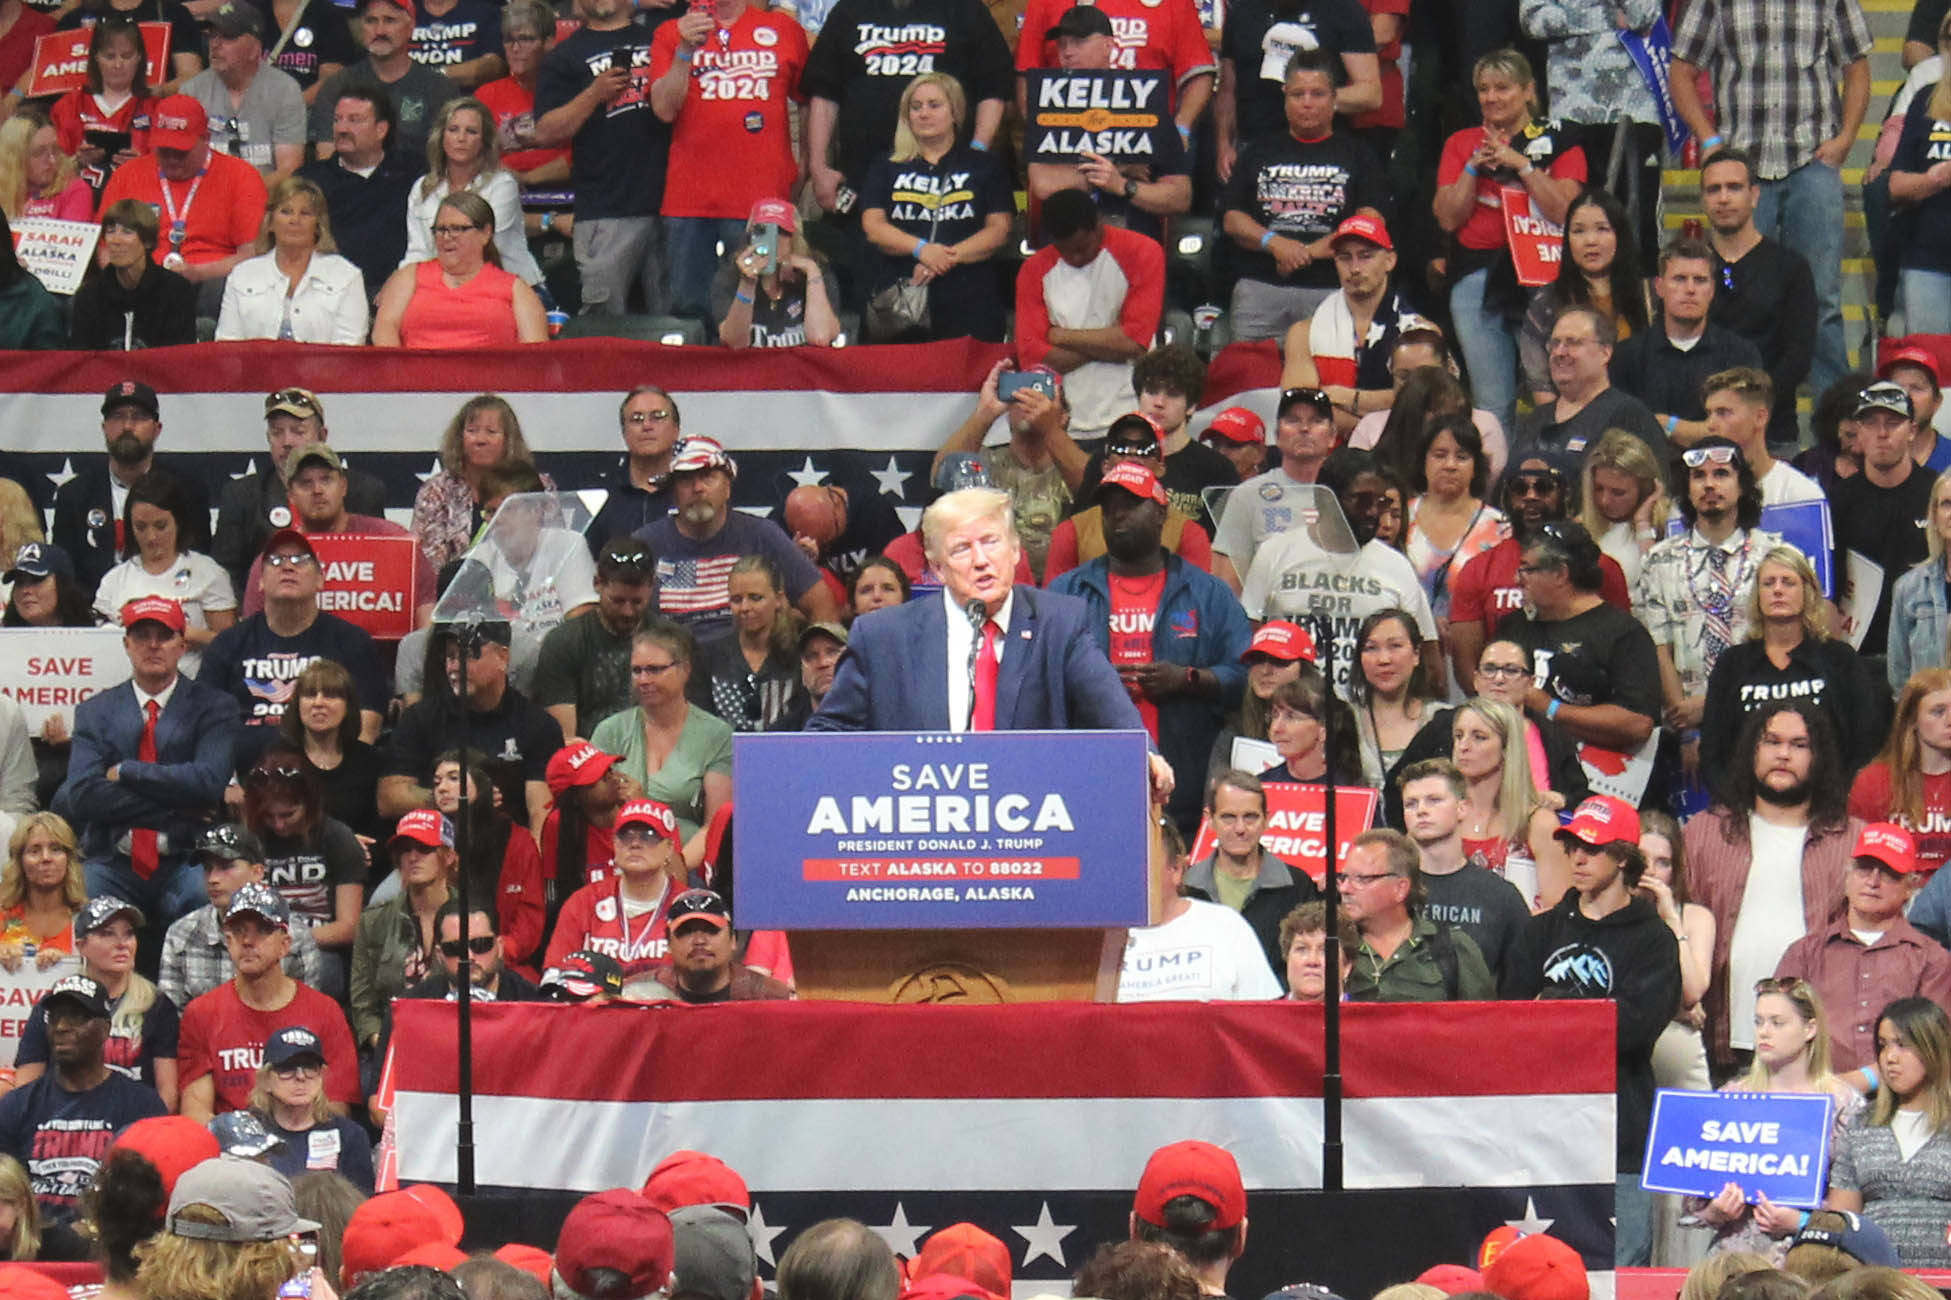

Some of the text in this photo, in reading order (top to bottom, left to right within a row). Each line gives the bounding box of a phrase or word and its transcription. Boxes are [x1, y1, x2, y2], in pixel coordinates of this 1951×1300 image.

[411, 23, 477, 42] RUMP
[857, 24, 945, 43] Trump
[408, 49, 463, 64] WON
[692, 50, 777, 68] Trump
[866, 55, 935, 75] 2024
[701, 80, 769, 100] 2024
[1038, 78, 1159, 109] KELLY
[1037, 131, 1153, 154] ALASKA
[1266, 165, 1340, 178] TRUMP
[894, 173, 970, 195] KELLY
[892, 204, 975, 221] ALASKA
[25, 232, 84, 247] SARAH
[21, 247, 77, 262] ALASKA
[1279, 572, 1382, 596] BLACKS
[1307, 593, 1352, 612] FOR
[27, 657, 93, 676] SAVE
[1741, 678, 1825, 701] TRUMP
[892, 764, 990, 791] SAVE
[806, 794, 1075, 834] AMERICA
[1269, 811, 1325, 831] AVE
[838, 838, 1043, 851] PRESIDENT DONALD J. TRUMP
[840, 862, 1043, 876] TEXT ALASKA TO 88022
[846, 887, 1035, 903] ANCHORAGE, ALASKA
[1701, 1121, 1780, 1144] SAVE
[32, 1131, 113, 1159] TRUMP
[1660, 1146, 1811, 1176] AMERICA!
[1801, 1231, 1830, 1240] 2024
